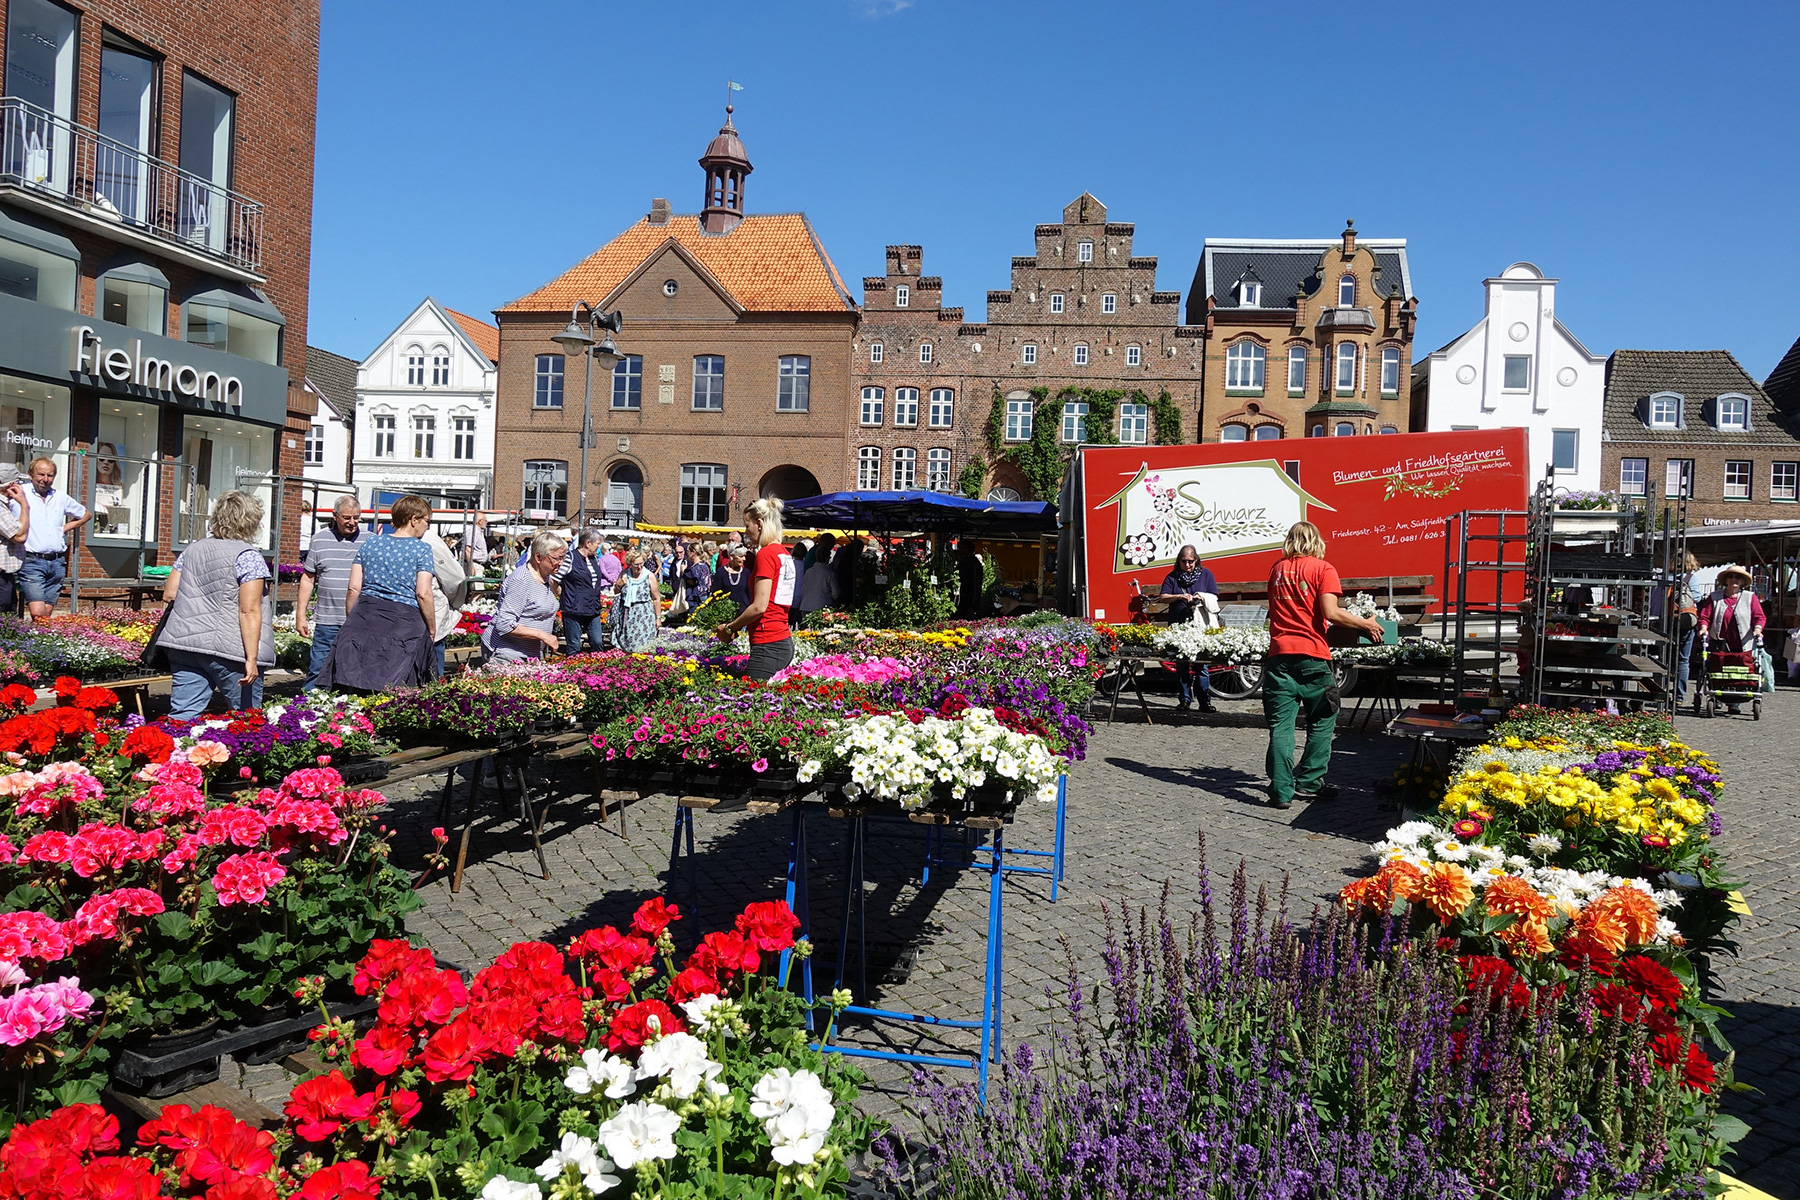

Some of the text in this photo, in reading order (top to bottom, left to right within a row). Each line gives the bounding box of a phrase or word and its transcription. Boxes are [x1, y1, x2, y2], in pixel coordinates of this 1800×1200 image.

[70, 325, 243, 407] fielmann
[6, 430, 53, 449] fielmann
[1332, 446, 1505, 483] Blumen- und Friedhofsgärtnerei
[1410, 460, 1512, 481] Wir lassen Qualität wachsen
[1174, 480, 1268, 524] Schwarz
[1331, 527, 1372, 539] Friedensstr.
[1373, 524, 1386, 534] 42
[1395, 521, 1410, 531] Am
[1703, 517, 1731, 526] Uhren
[1400, 534, 1418, 544] 0481
[1424, 531, 1439, 540] 626
